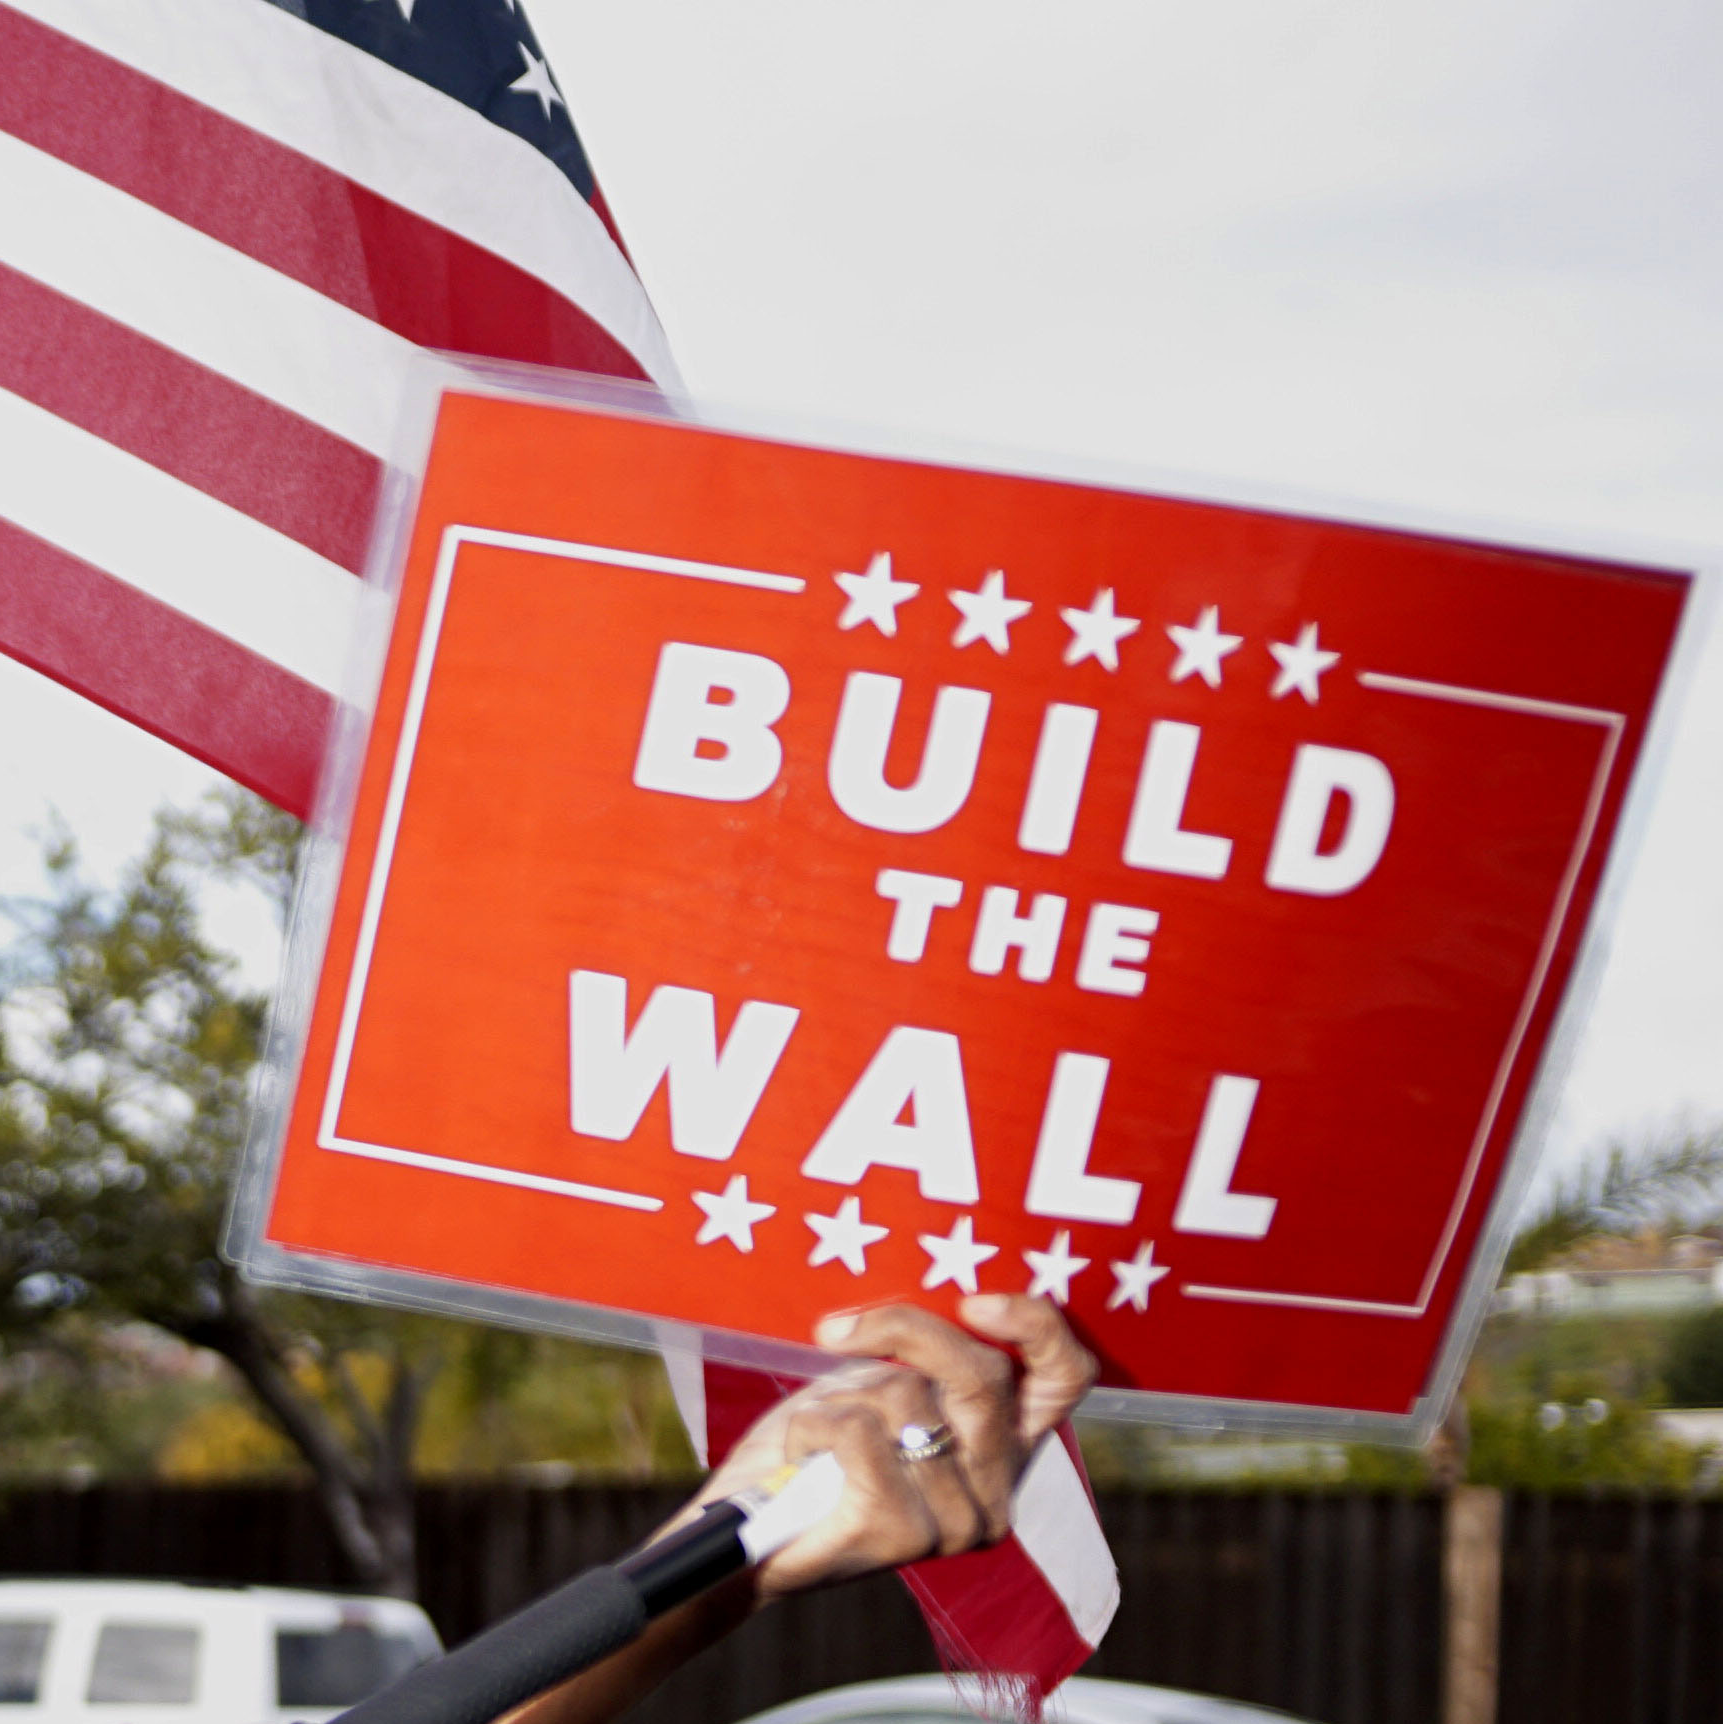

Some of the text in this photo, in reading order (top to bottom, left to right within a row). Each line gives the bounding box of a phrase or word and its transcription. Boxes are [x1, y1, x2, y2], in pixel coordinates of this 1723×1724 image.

[633, 641, 1397, 897] BUILD
[874, 868, 1161, 997] THE
[567, 969, 1279, 1241] WALL
